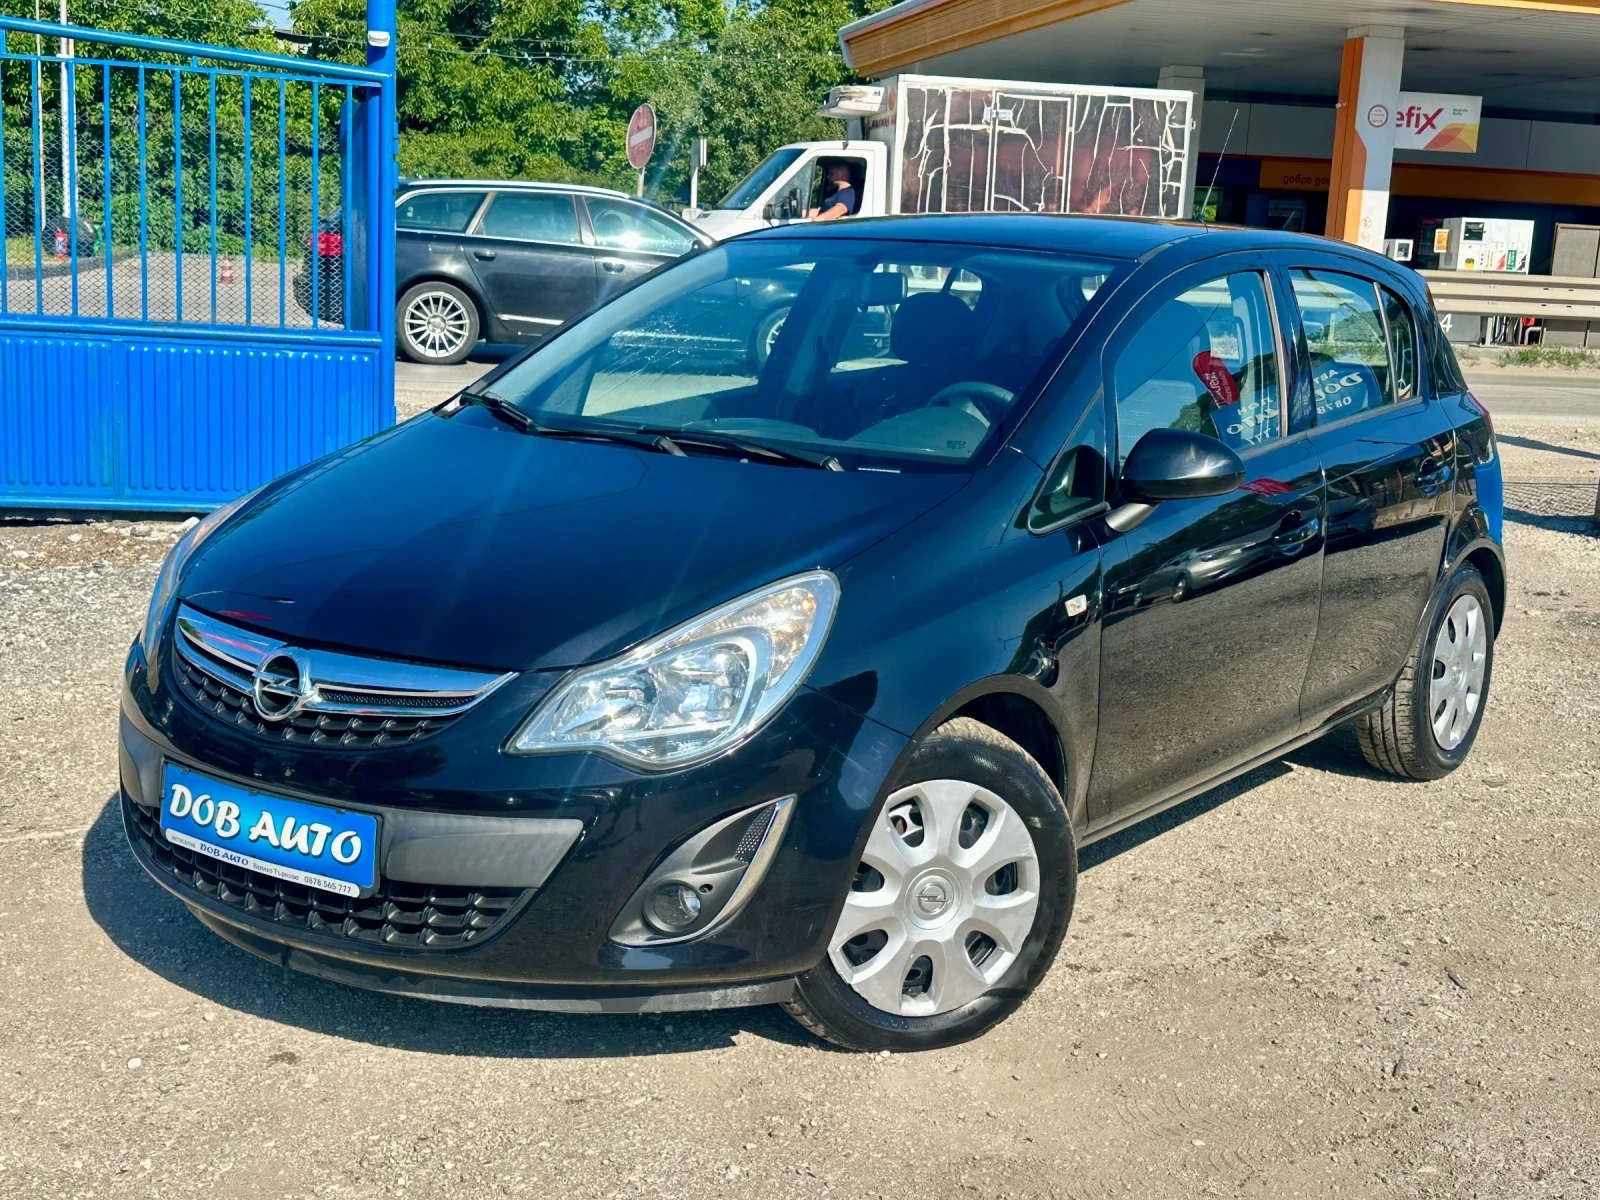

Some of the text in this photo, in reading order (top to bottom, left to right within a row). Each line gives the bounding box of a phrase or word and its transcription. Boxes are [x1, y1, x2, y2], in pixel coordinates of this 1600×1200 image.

[1439, 313, 1453, 333] 4
[169, 783, 363, 864] DOB AUTO
[199, 843, 221, 858] DOB
[221, 852, 249, 866] AUTO
[303, 875, 322, 887] 0878
[323, 880, 337, 891] 565
[337, 884, 352, 894] 777
